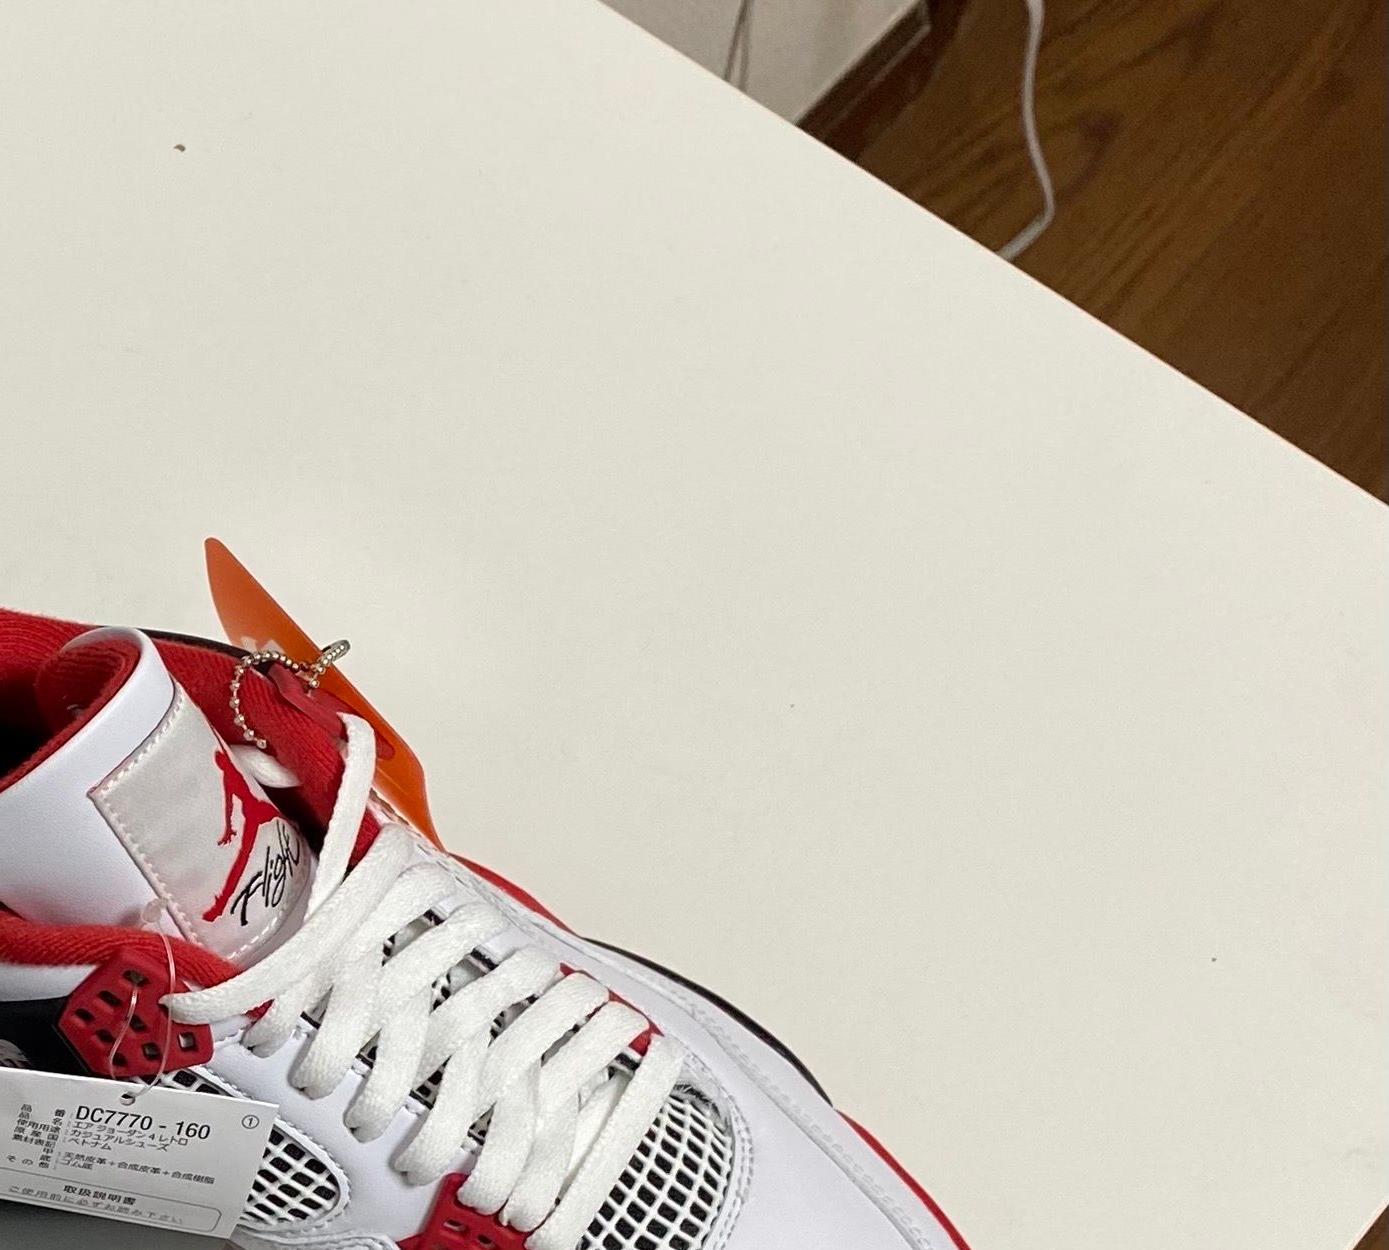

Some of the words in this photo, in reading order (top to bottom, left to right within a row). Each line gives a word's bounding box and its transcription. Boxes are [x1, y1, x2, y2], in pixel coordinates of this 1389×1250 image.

[230, 820, 301, 926] Flight
[68, 1137, 112, 1150] ベトナム
[62, 1184, 137, 1206] 取扱説明書
